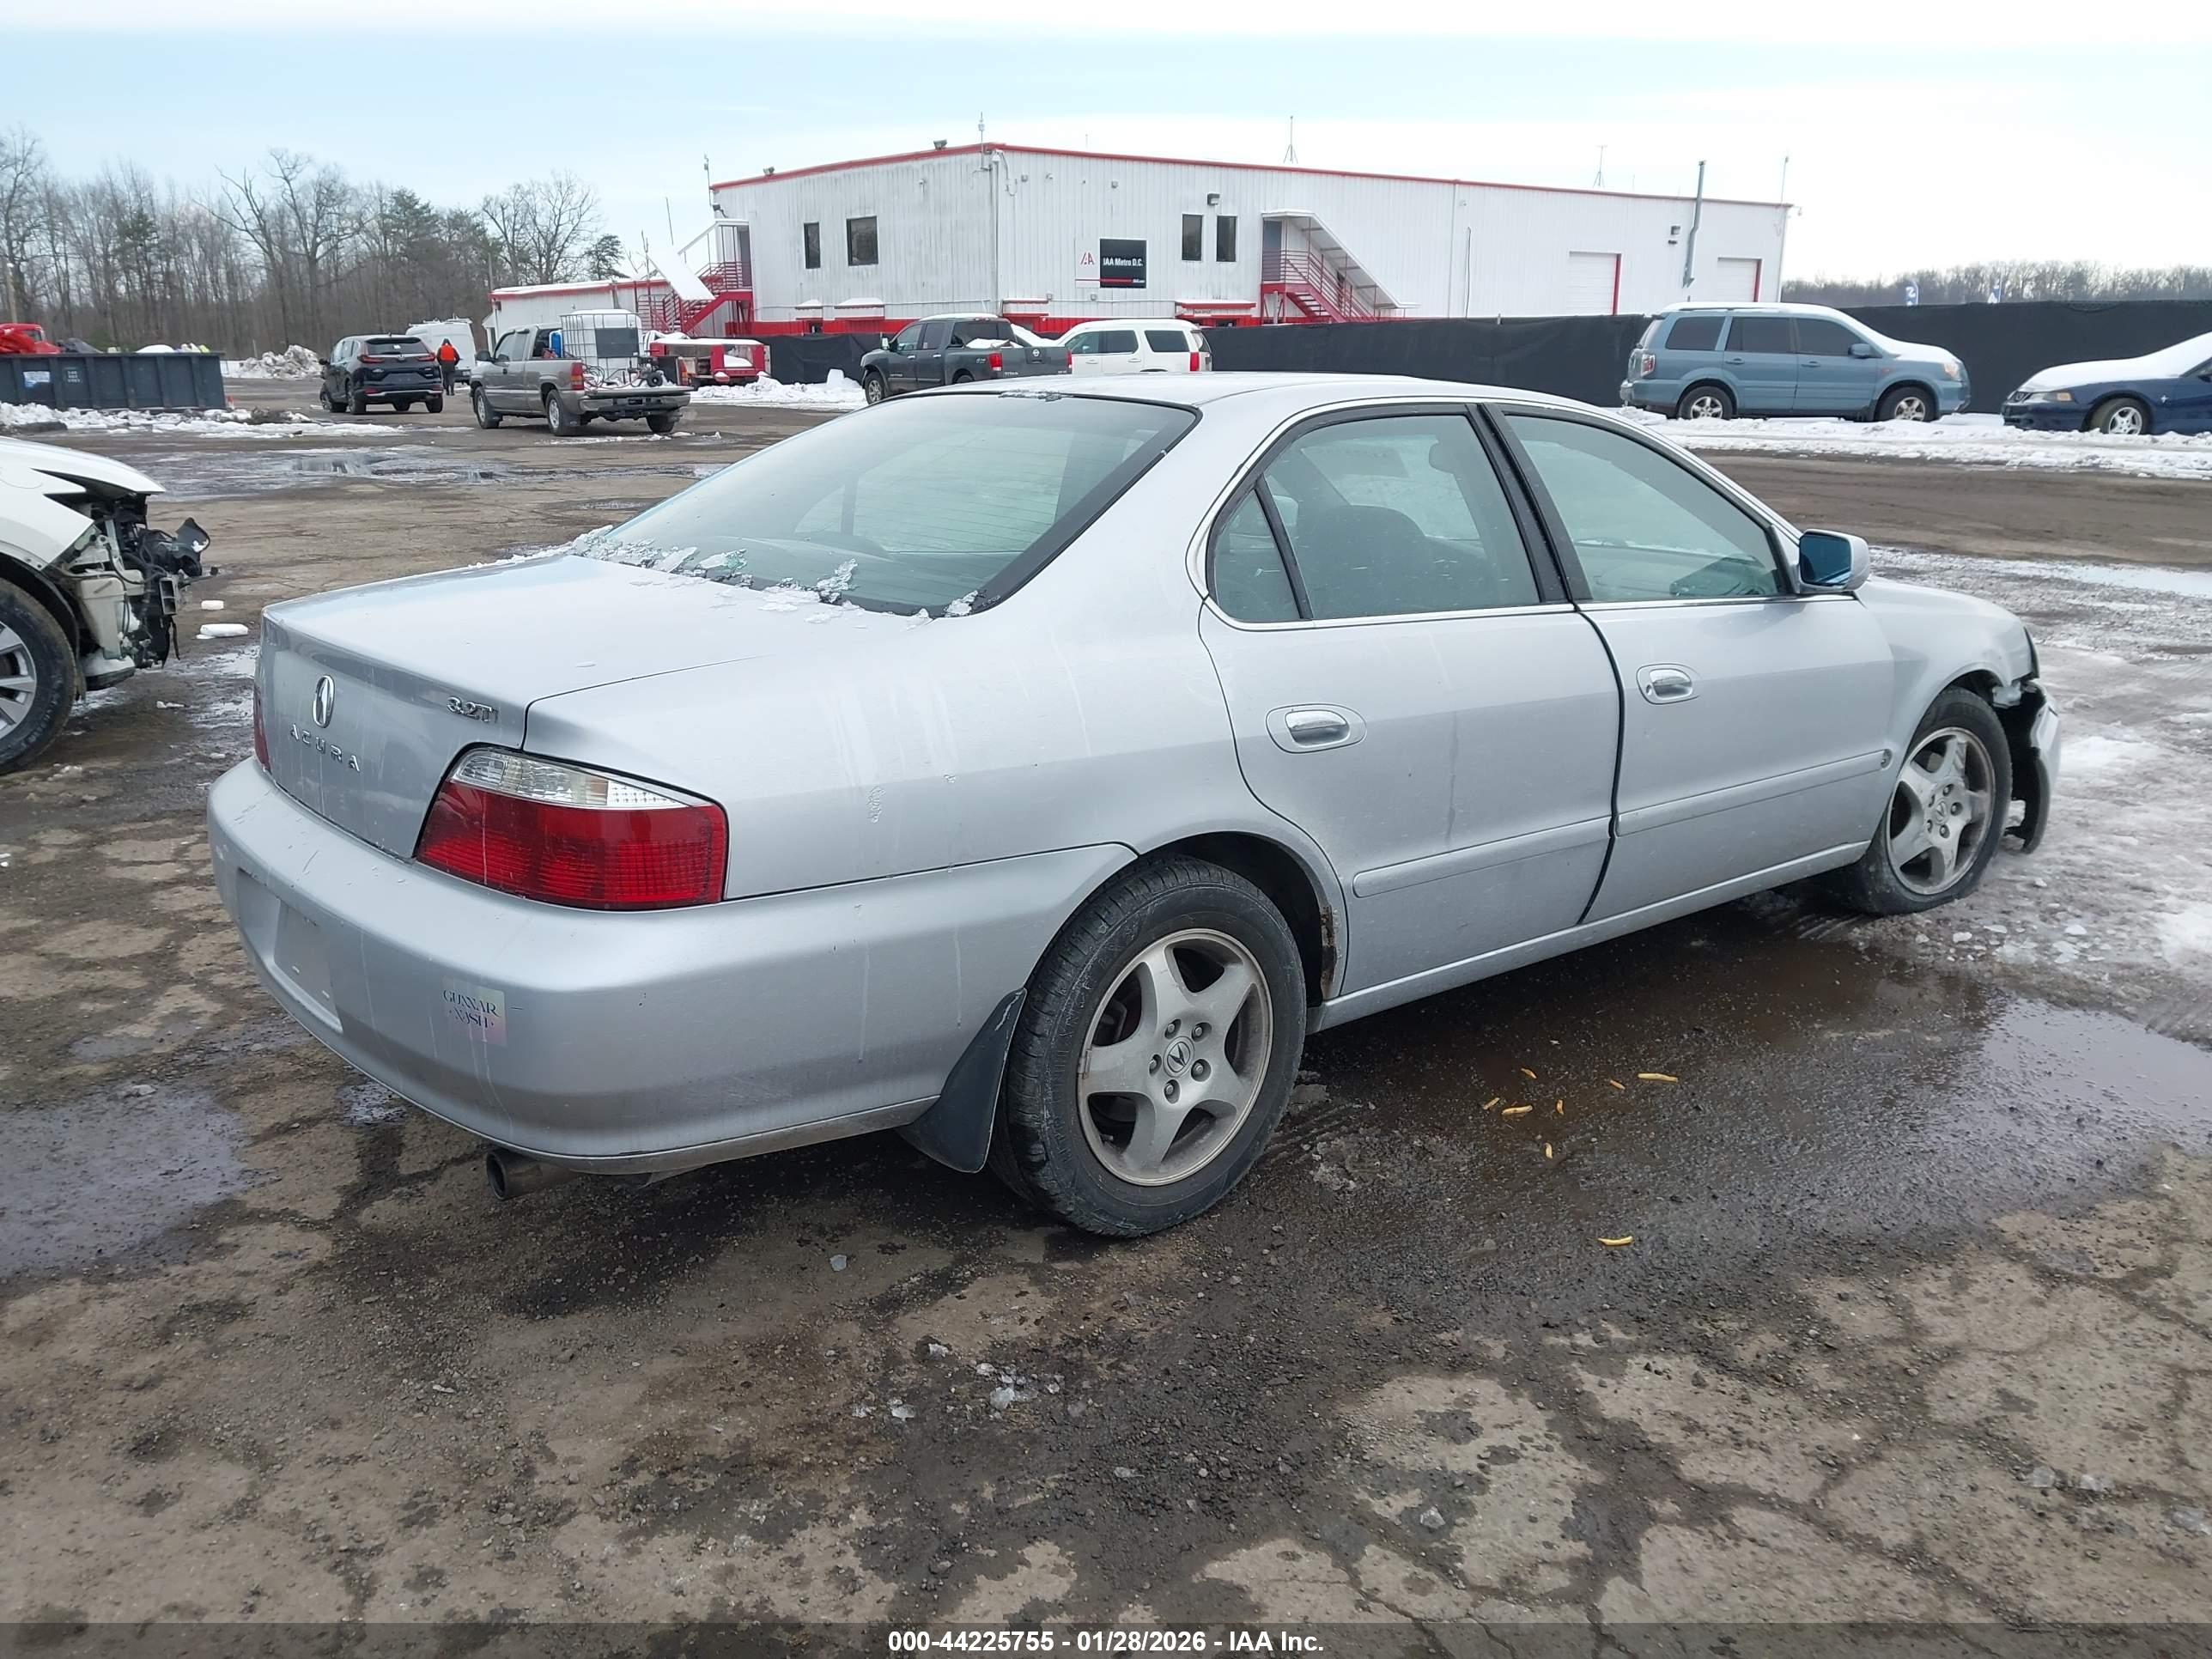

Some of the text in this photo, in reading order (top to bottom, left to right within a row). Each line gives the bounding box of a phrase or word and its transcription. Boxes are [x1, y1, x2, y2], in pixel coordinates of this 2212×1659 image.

[1103, 257, 1144, 267] IAA Metro D.C.
[289, 723, 361, 773] ACURA
[442, 989, 501, 1018] GUNNAR
